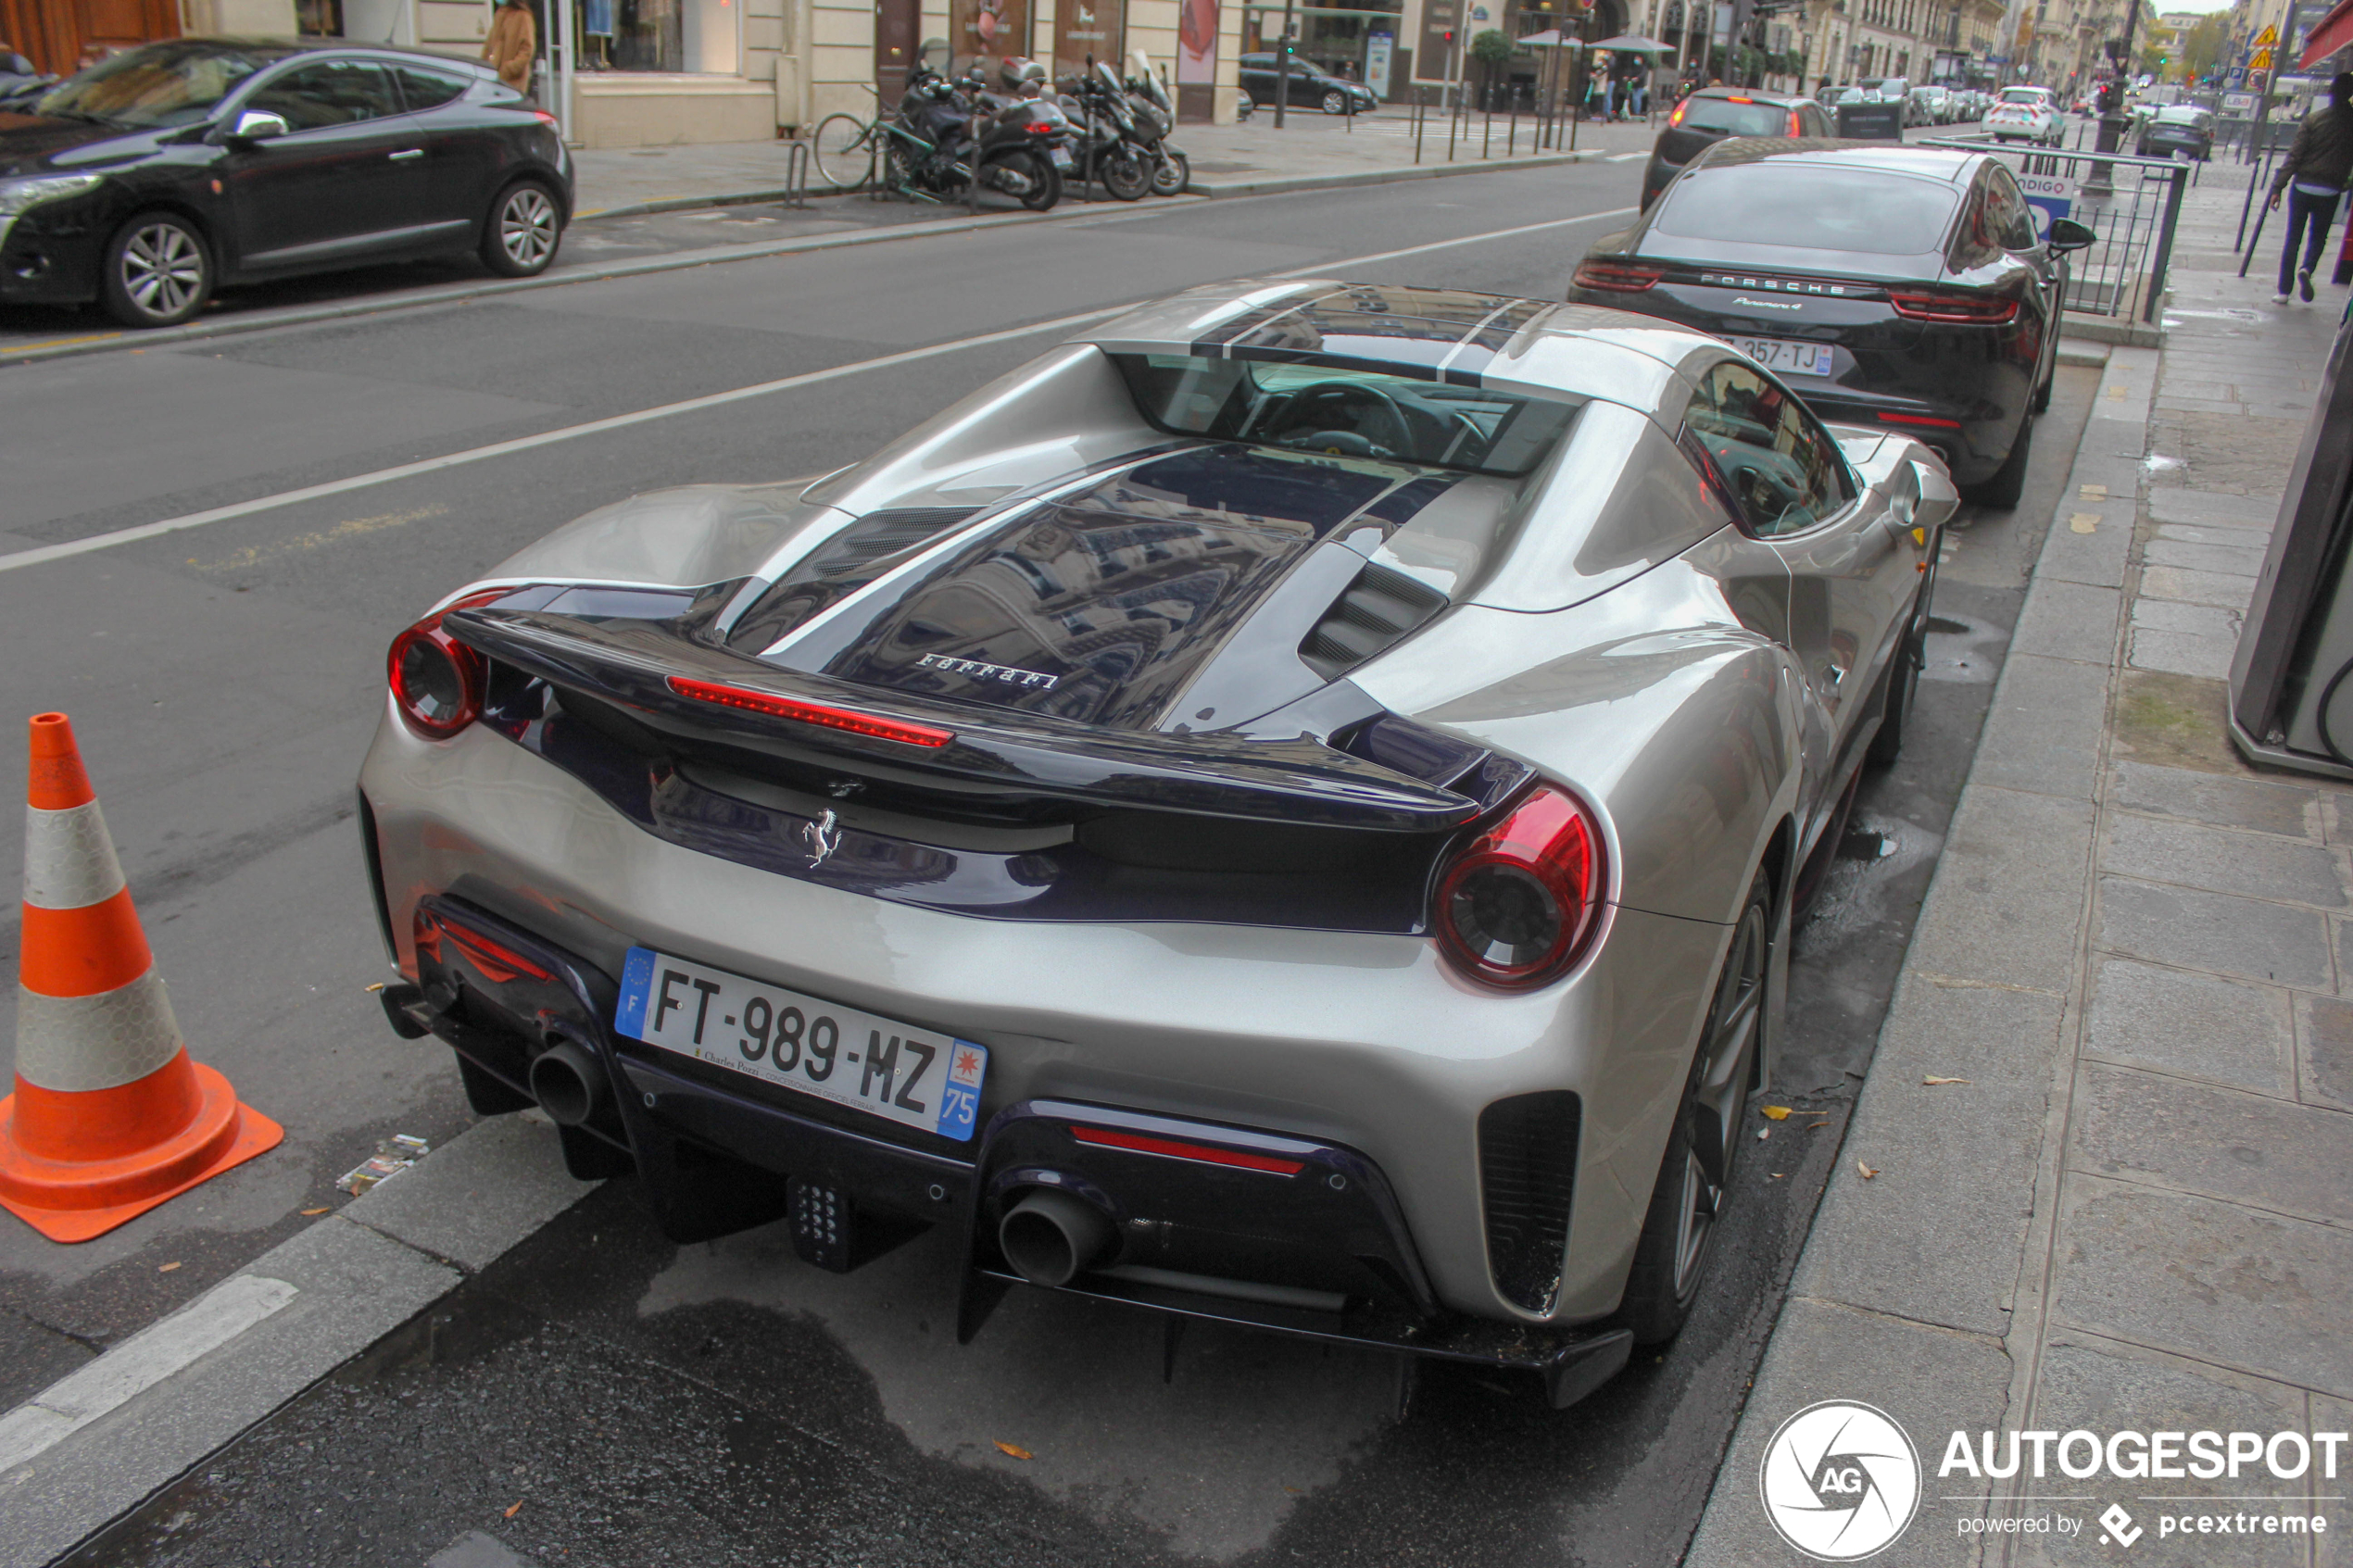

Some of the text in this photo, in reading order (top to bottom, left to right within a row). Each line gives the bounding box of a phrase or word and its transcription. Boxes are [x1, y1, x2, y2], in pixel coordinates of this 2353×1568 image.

[2231, 69, 2241, 79] P
[2017, 178, 2065, 194] NDIGO
[1700, 274, 1845, 295] PORSCHE
[1732, 296, 1790, 310] Panamera
[915, 652, 1059, 690] Ferrari
[627, 994, 639, 1012] F
[653, 968, 937, 1115] FT-989-MZ
[704, 1051, 875, 1111] Charles Pozzi CONCESSIONNAIRE OFFICIEL FERRARI
[942, 1087, 975, 1125] 75
